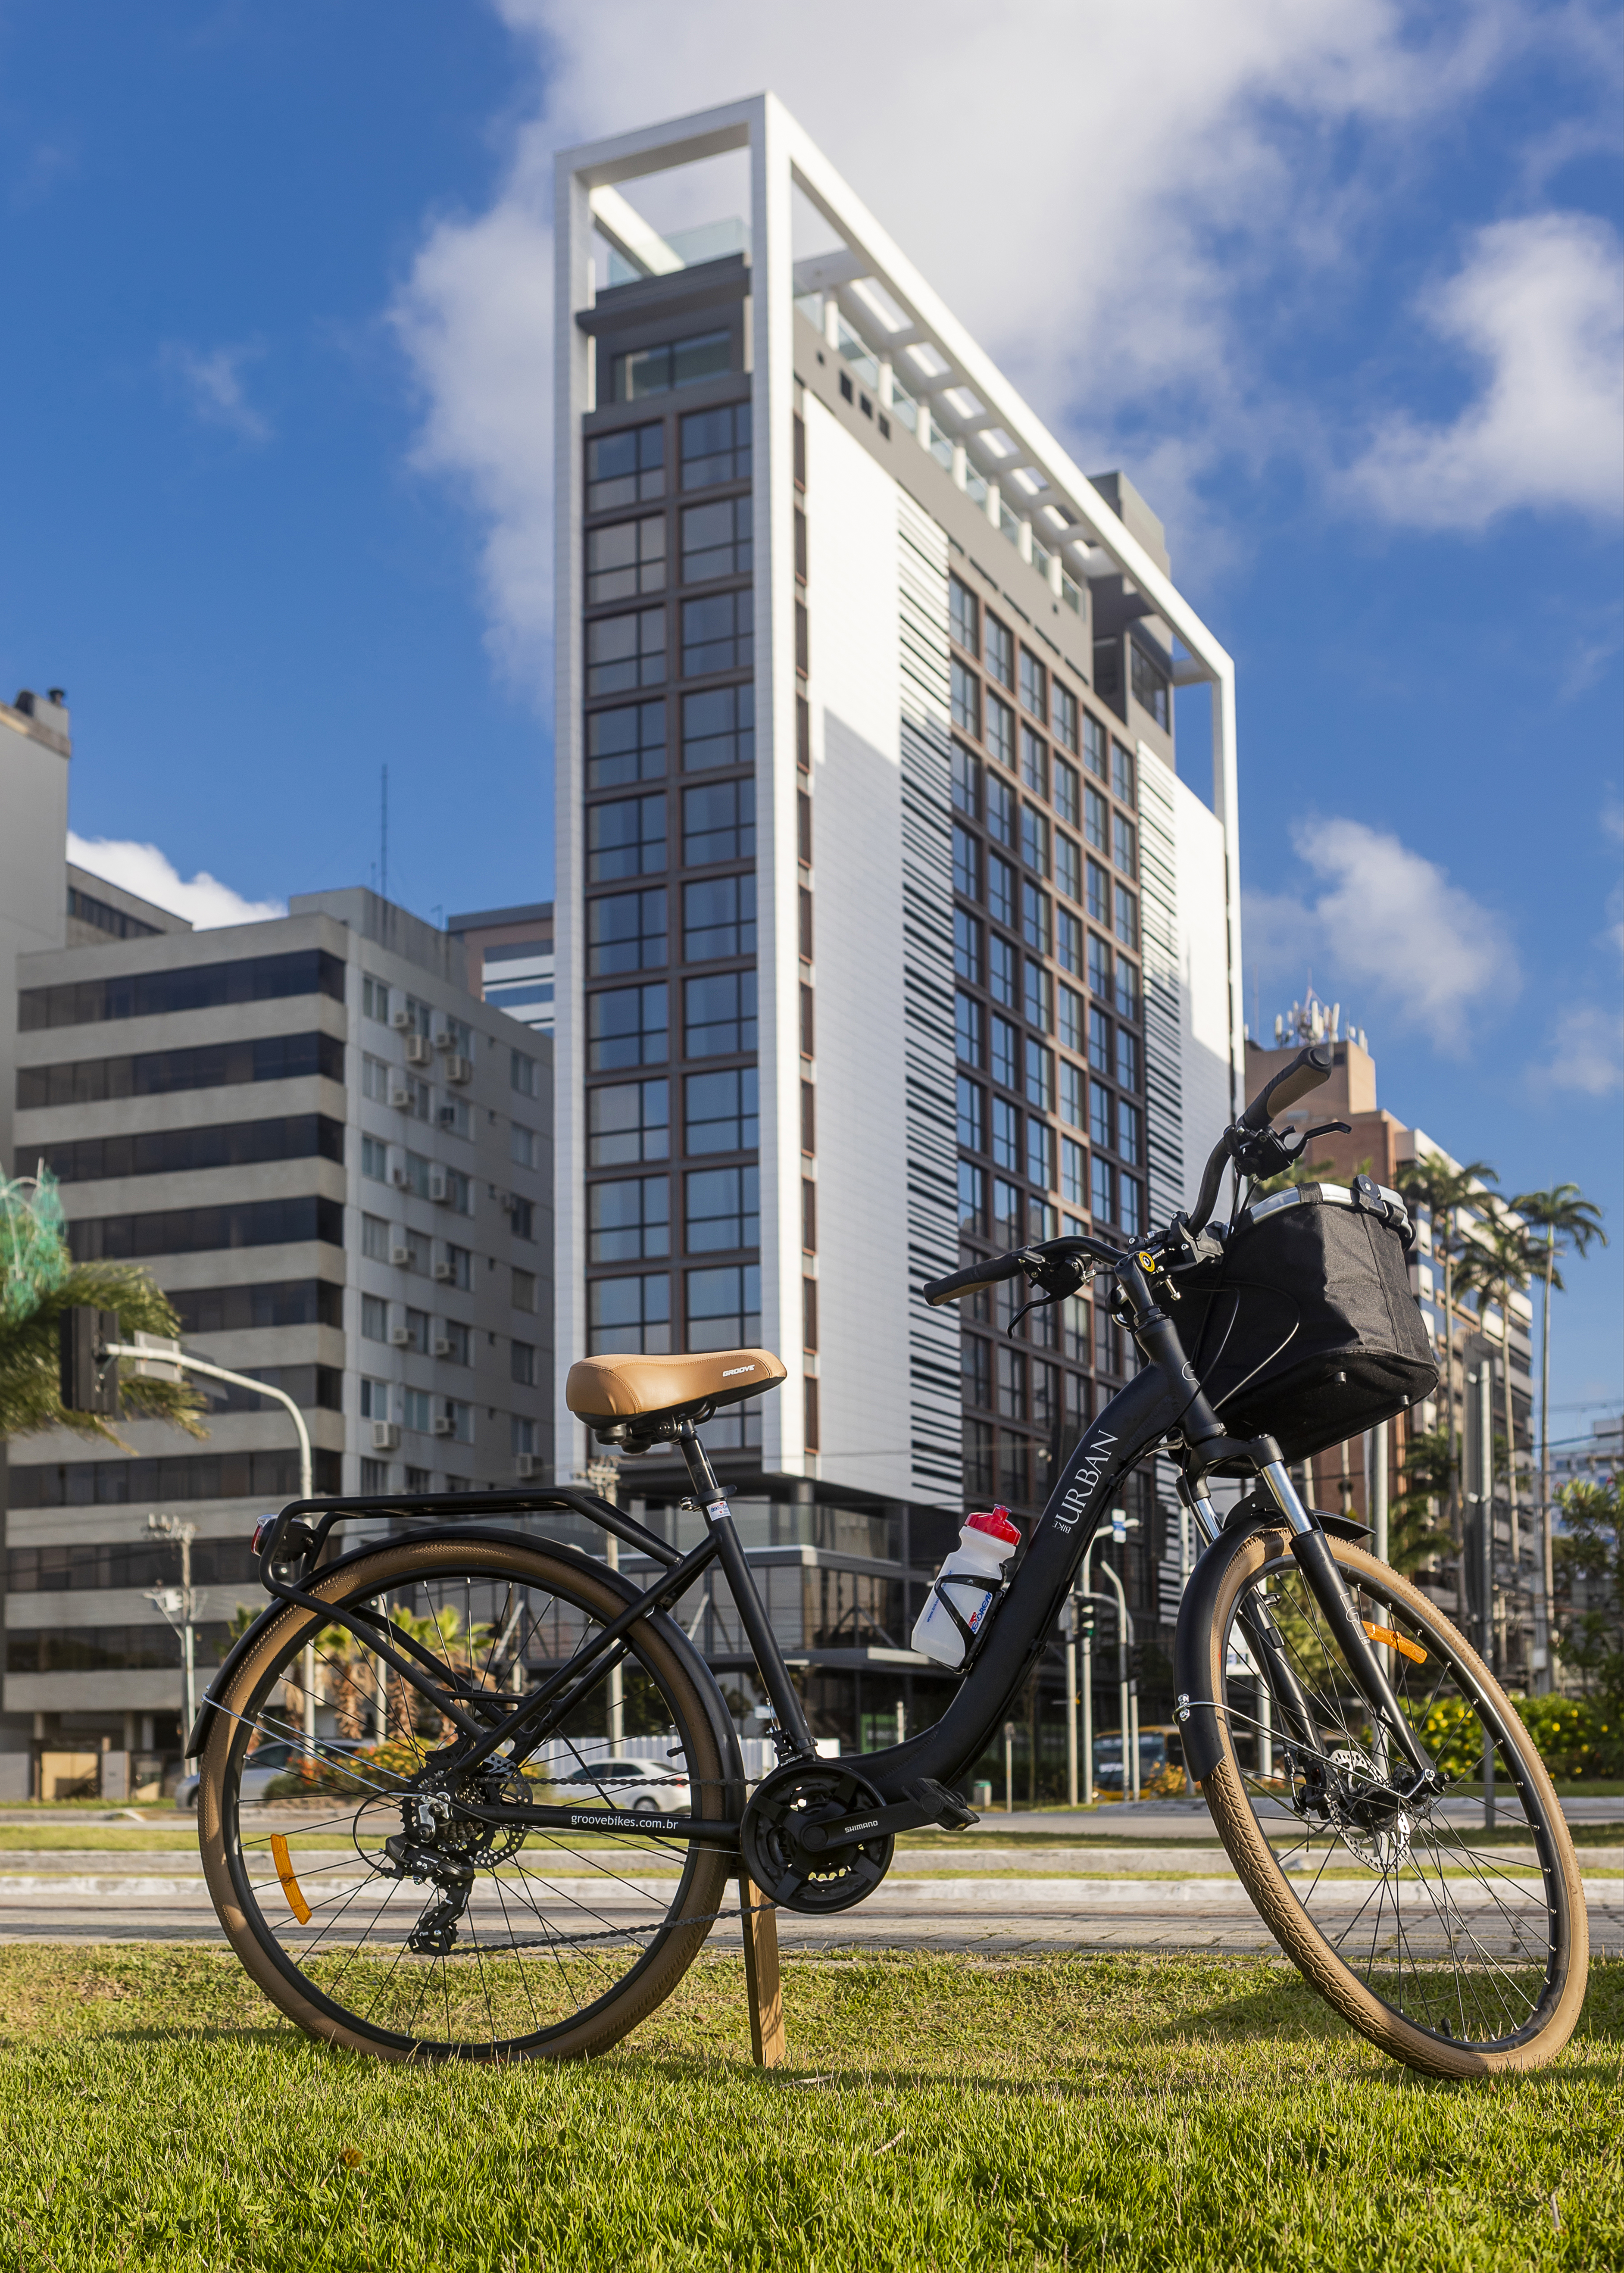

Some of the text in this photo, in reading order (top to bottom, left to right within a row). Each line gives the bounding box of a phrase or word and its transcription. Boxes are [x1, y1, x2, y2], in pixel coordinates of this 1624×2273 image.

[722, 1364, 755, 1377] GROOVE
[1055, 1429, 1118, 1524] URBAN
[1052, 1520, 1071, 1534] BIKE
[571, 1813, 679, 1830] groovebikes.com.br
[845, 1820, 878, 1833] SHIMANO
